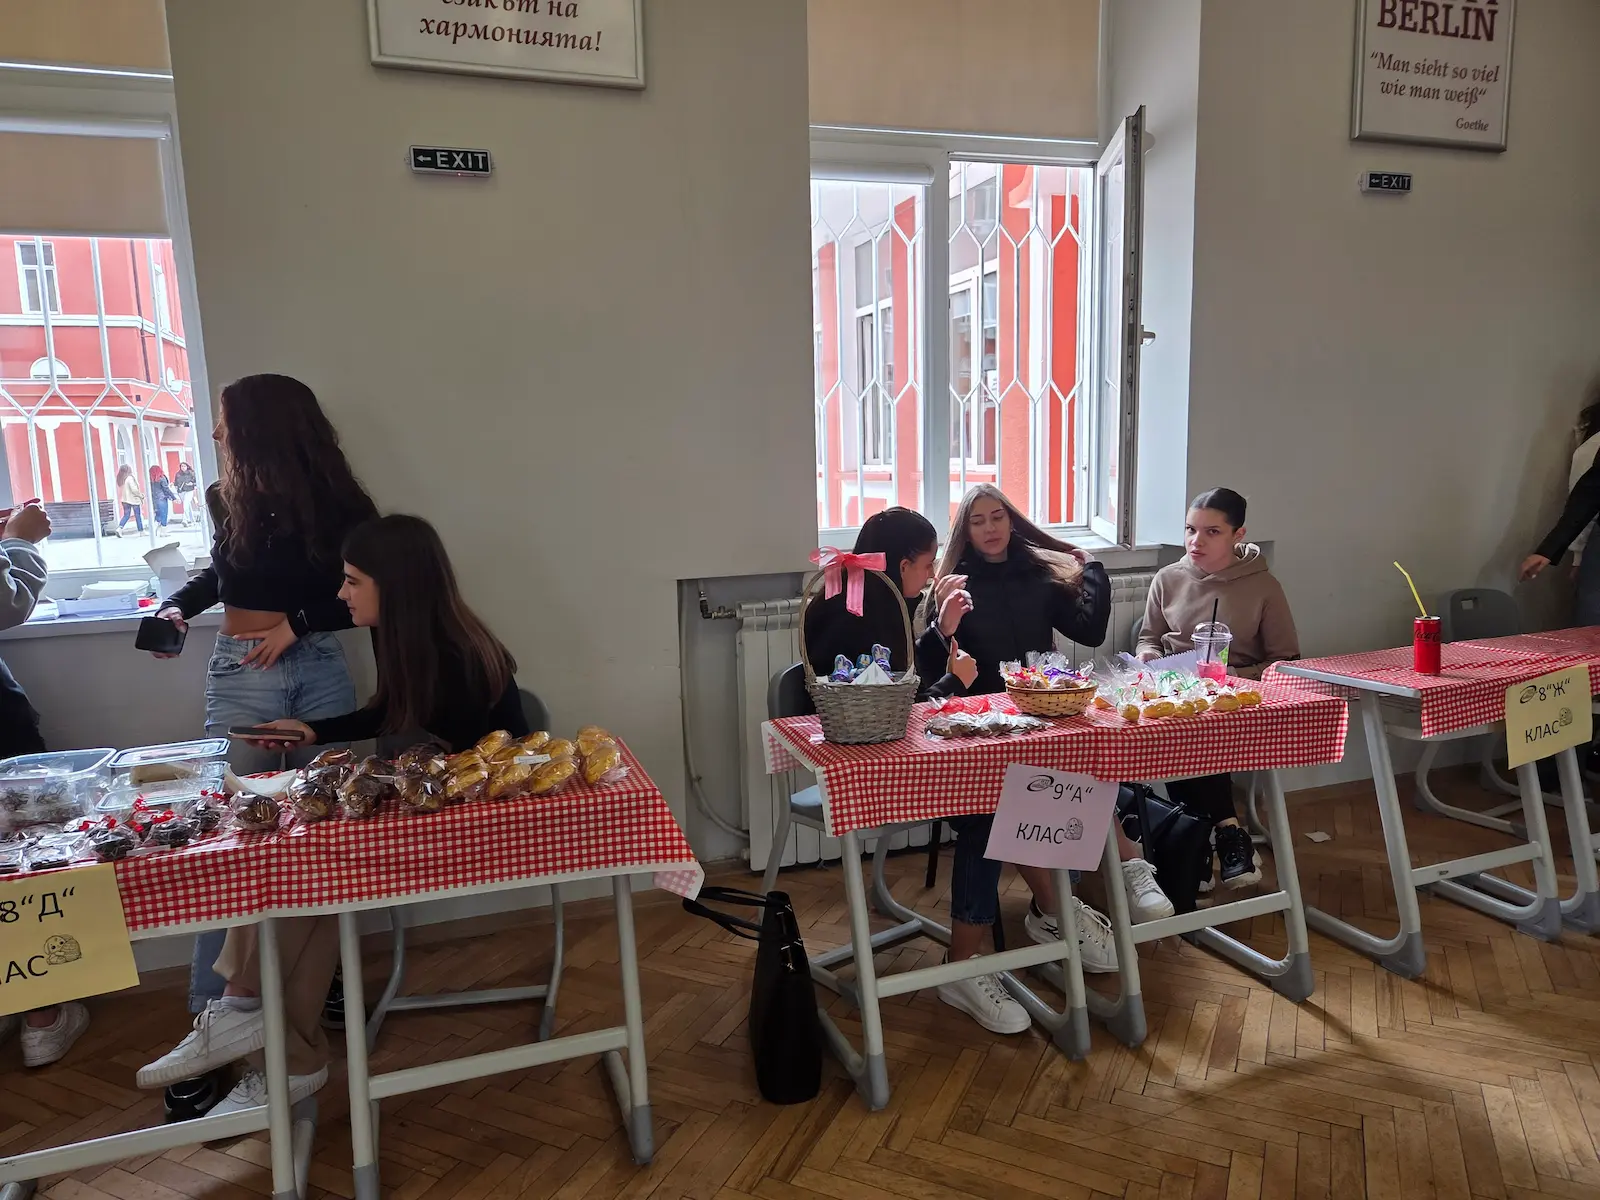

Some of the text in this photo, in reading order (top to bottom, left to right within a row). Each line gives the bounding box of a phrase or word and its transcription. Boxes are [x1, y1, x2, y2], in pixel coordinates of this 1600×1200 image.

[548, 1, 579, 18] на
[1377, 0, 1499, 41] BERLIN
[419, 17, 602, 51] хармонията!
[1413, 58, 1449, 78] sieht
[1451, 66, 1468, 80] so
[1471, 64, 1500, 82] viel
[1380, 78, 1407, 96] wie
[1409, 85, 1441, 100] man
[1455, 117, 1490, 131] Goethe
[436, 151, 487, 170] EXIT
[1381, 175, 1411, 189] EXIT
[1525, 720, 1560, 744] КЛАС
[1016, 822, 1065, 845] КЛАС
